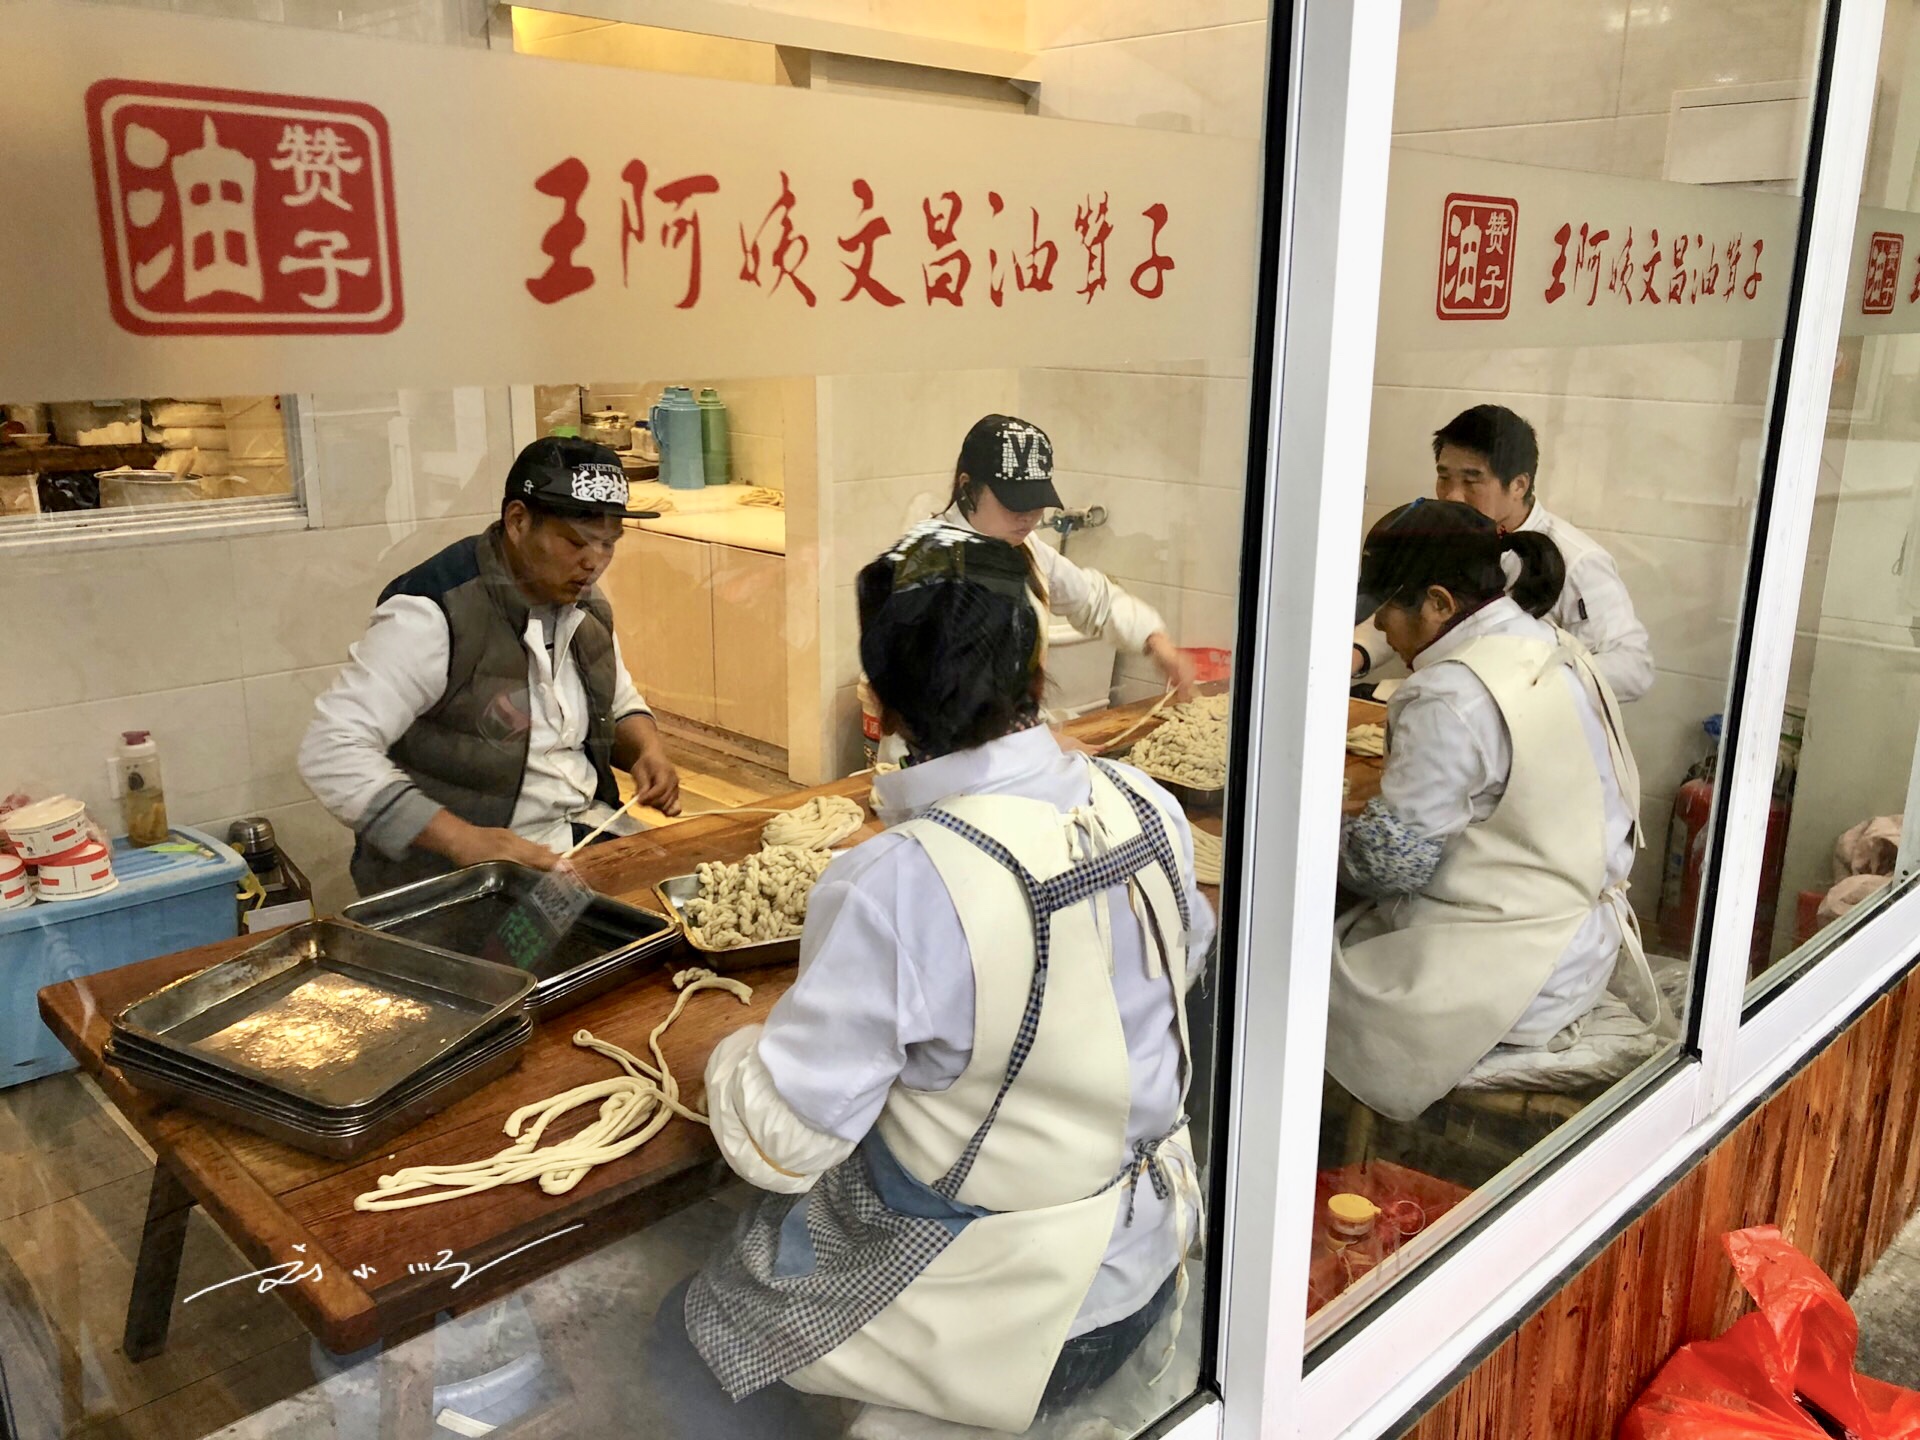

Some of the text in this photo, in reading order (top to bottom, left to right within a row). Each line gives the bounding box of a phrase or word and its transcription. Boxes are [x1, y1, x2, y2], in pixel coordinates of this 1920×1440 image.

[124, 114, 265, 303] 油
[269, 124, 371, 309] 赞子
[1444, 208, 1482, 304] 油
[1480, 211, 1510, 307] 赞子
